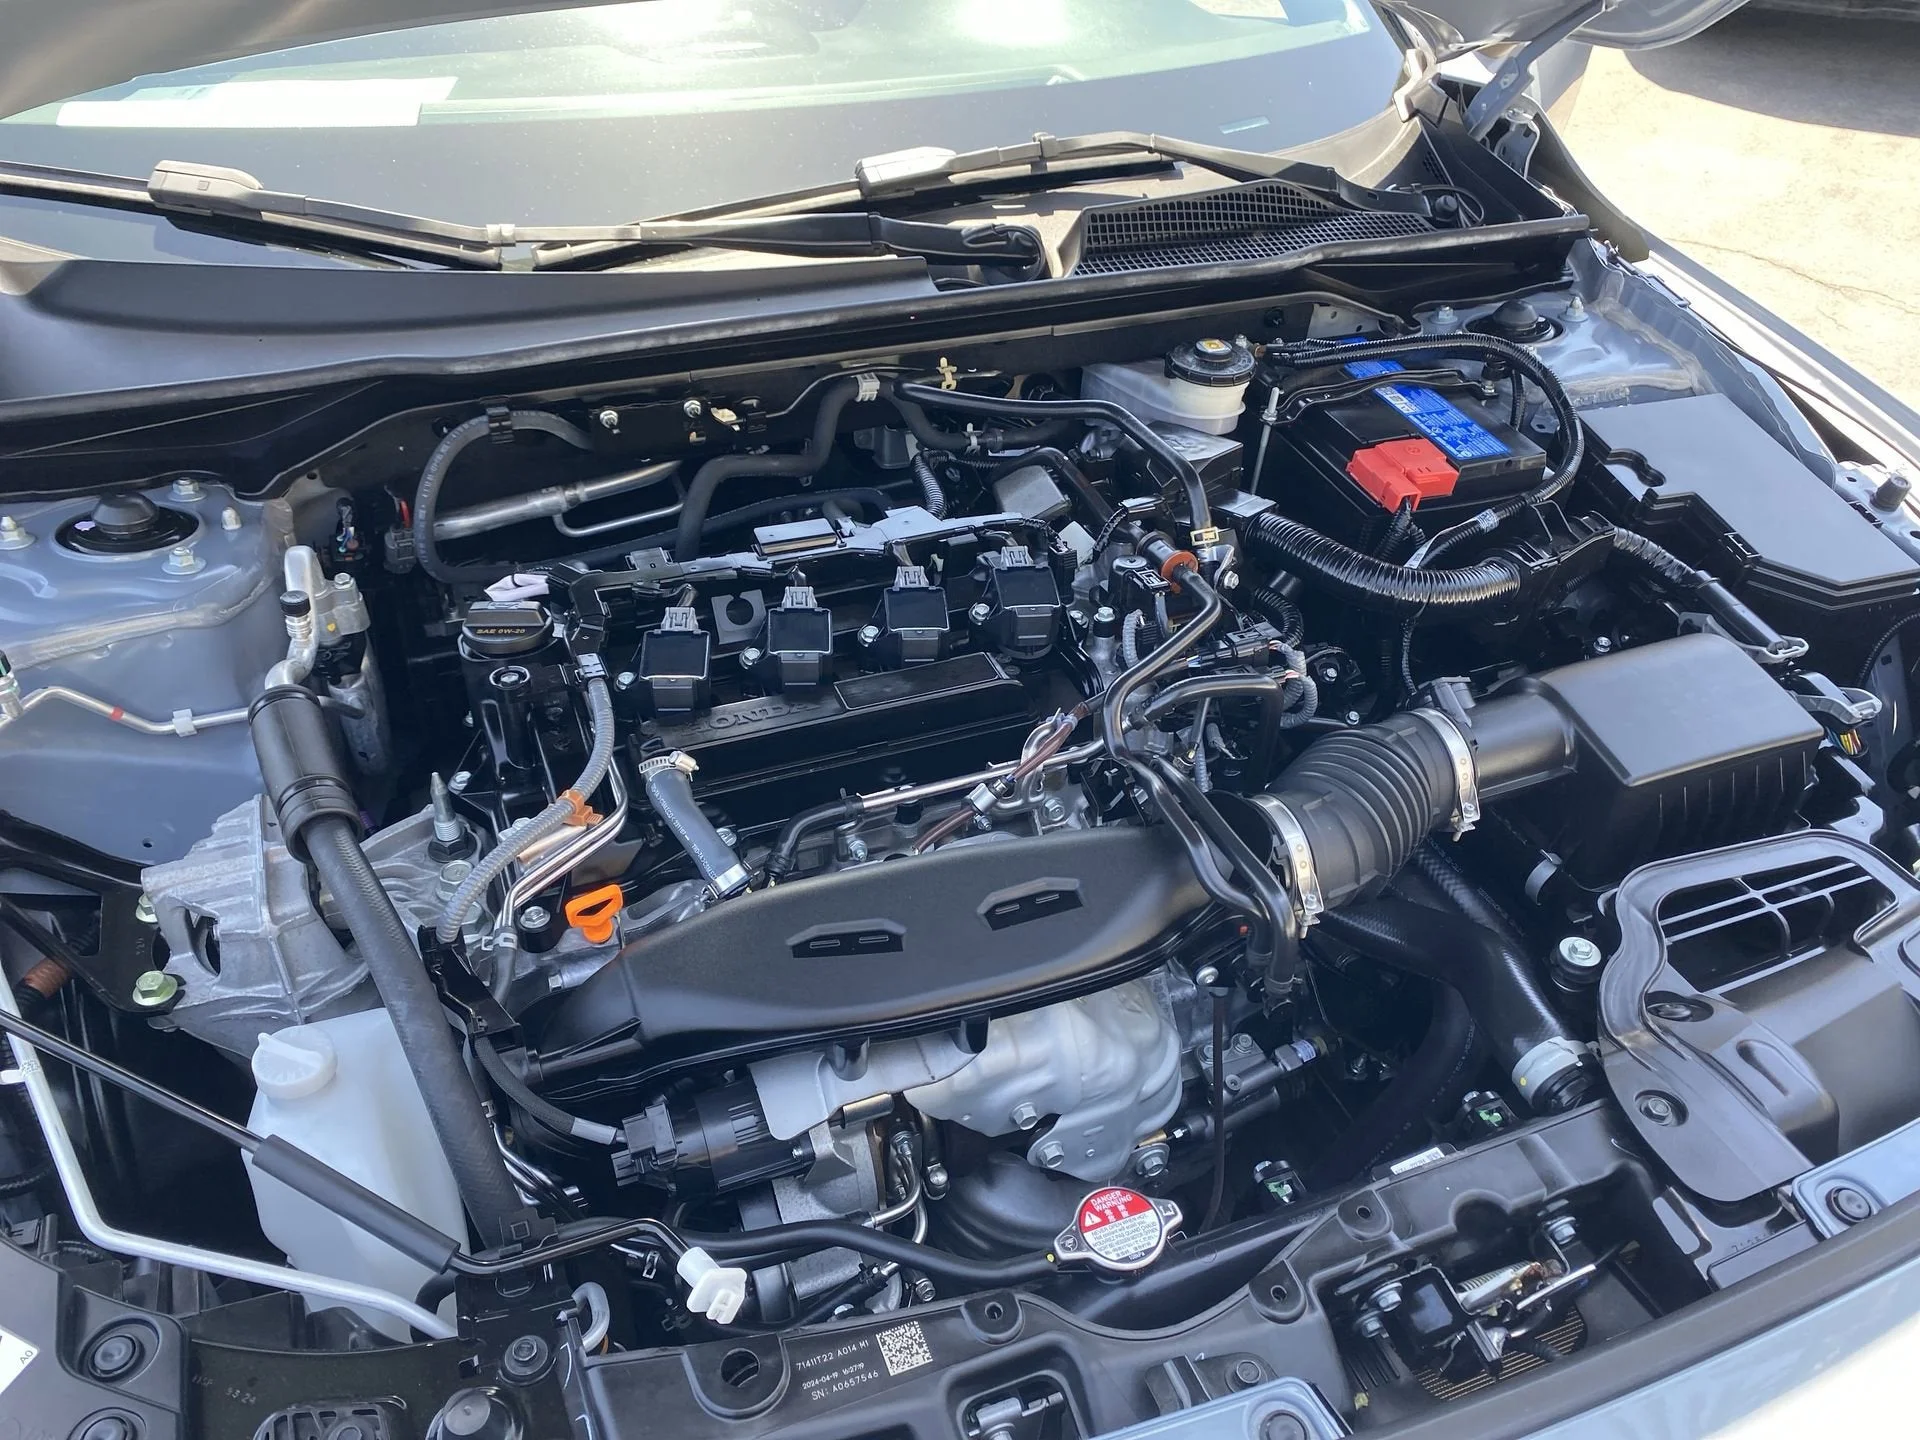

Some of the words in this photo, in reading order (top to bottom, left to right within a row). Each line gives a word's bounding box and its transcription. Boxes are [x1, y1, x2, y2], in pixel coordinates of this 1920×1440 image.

[680, 702, 820, 736] HONDA
[1091, 1191, 1122, 1204] DANGER
[1094, 1194, 1133, 1212] WARNUNG
[796, 1352, 834, 1371] 71411T22
[837, 1343, 857, 1357] A014
[802, 1372, 839, 1390] 2024-04-19
[811, 1388, 829, 1400] SN:
[832, 1370, 879, 1393] A0657546
